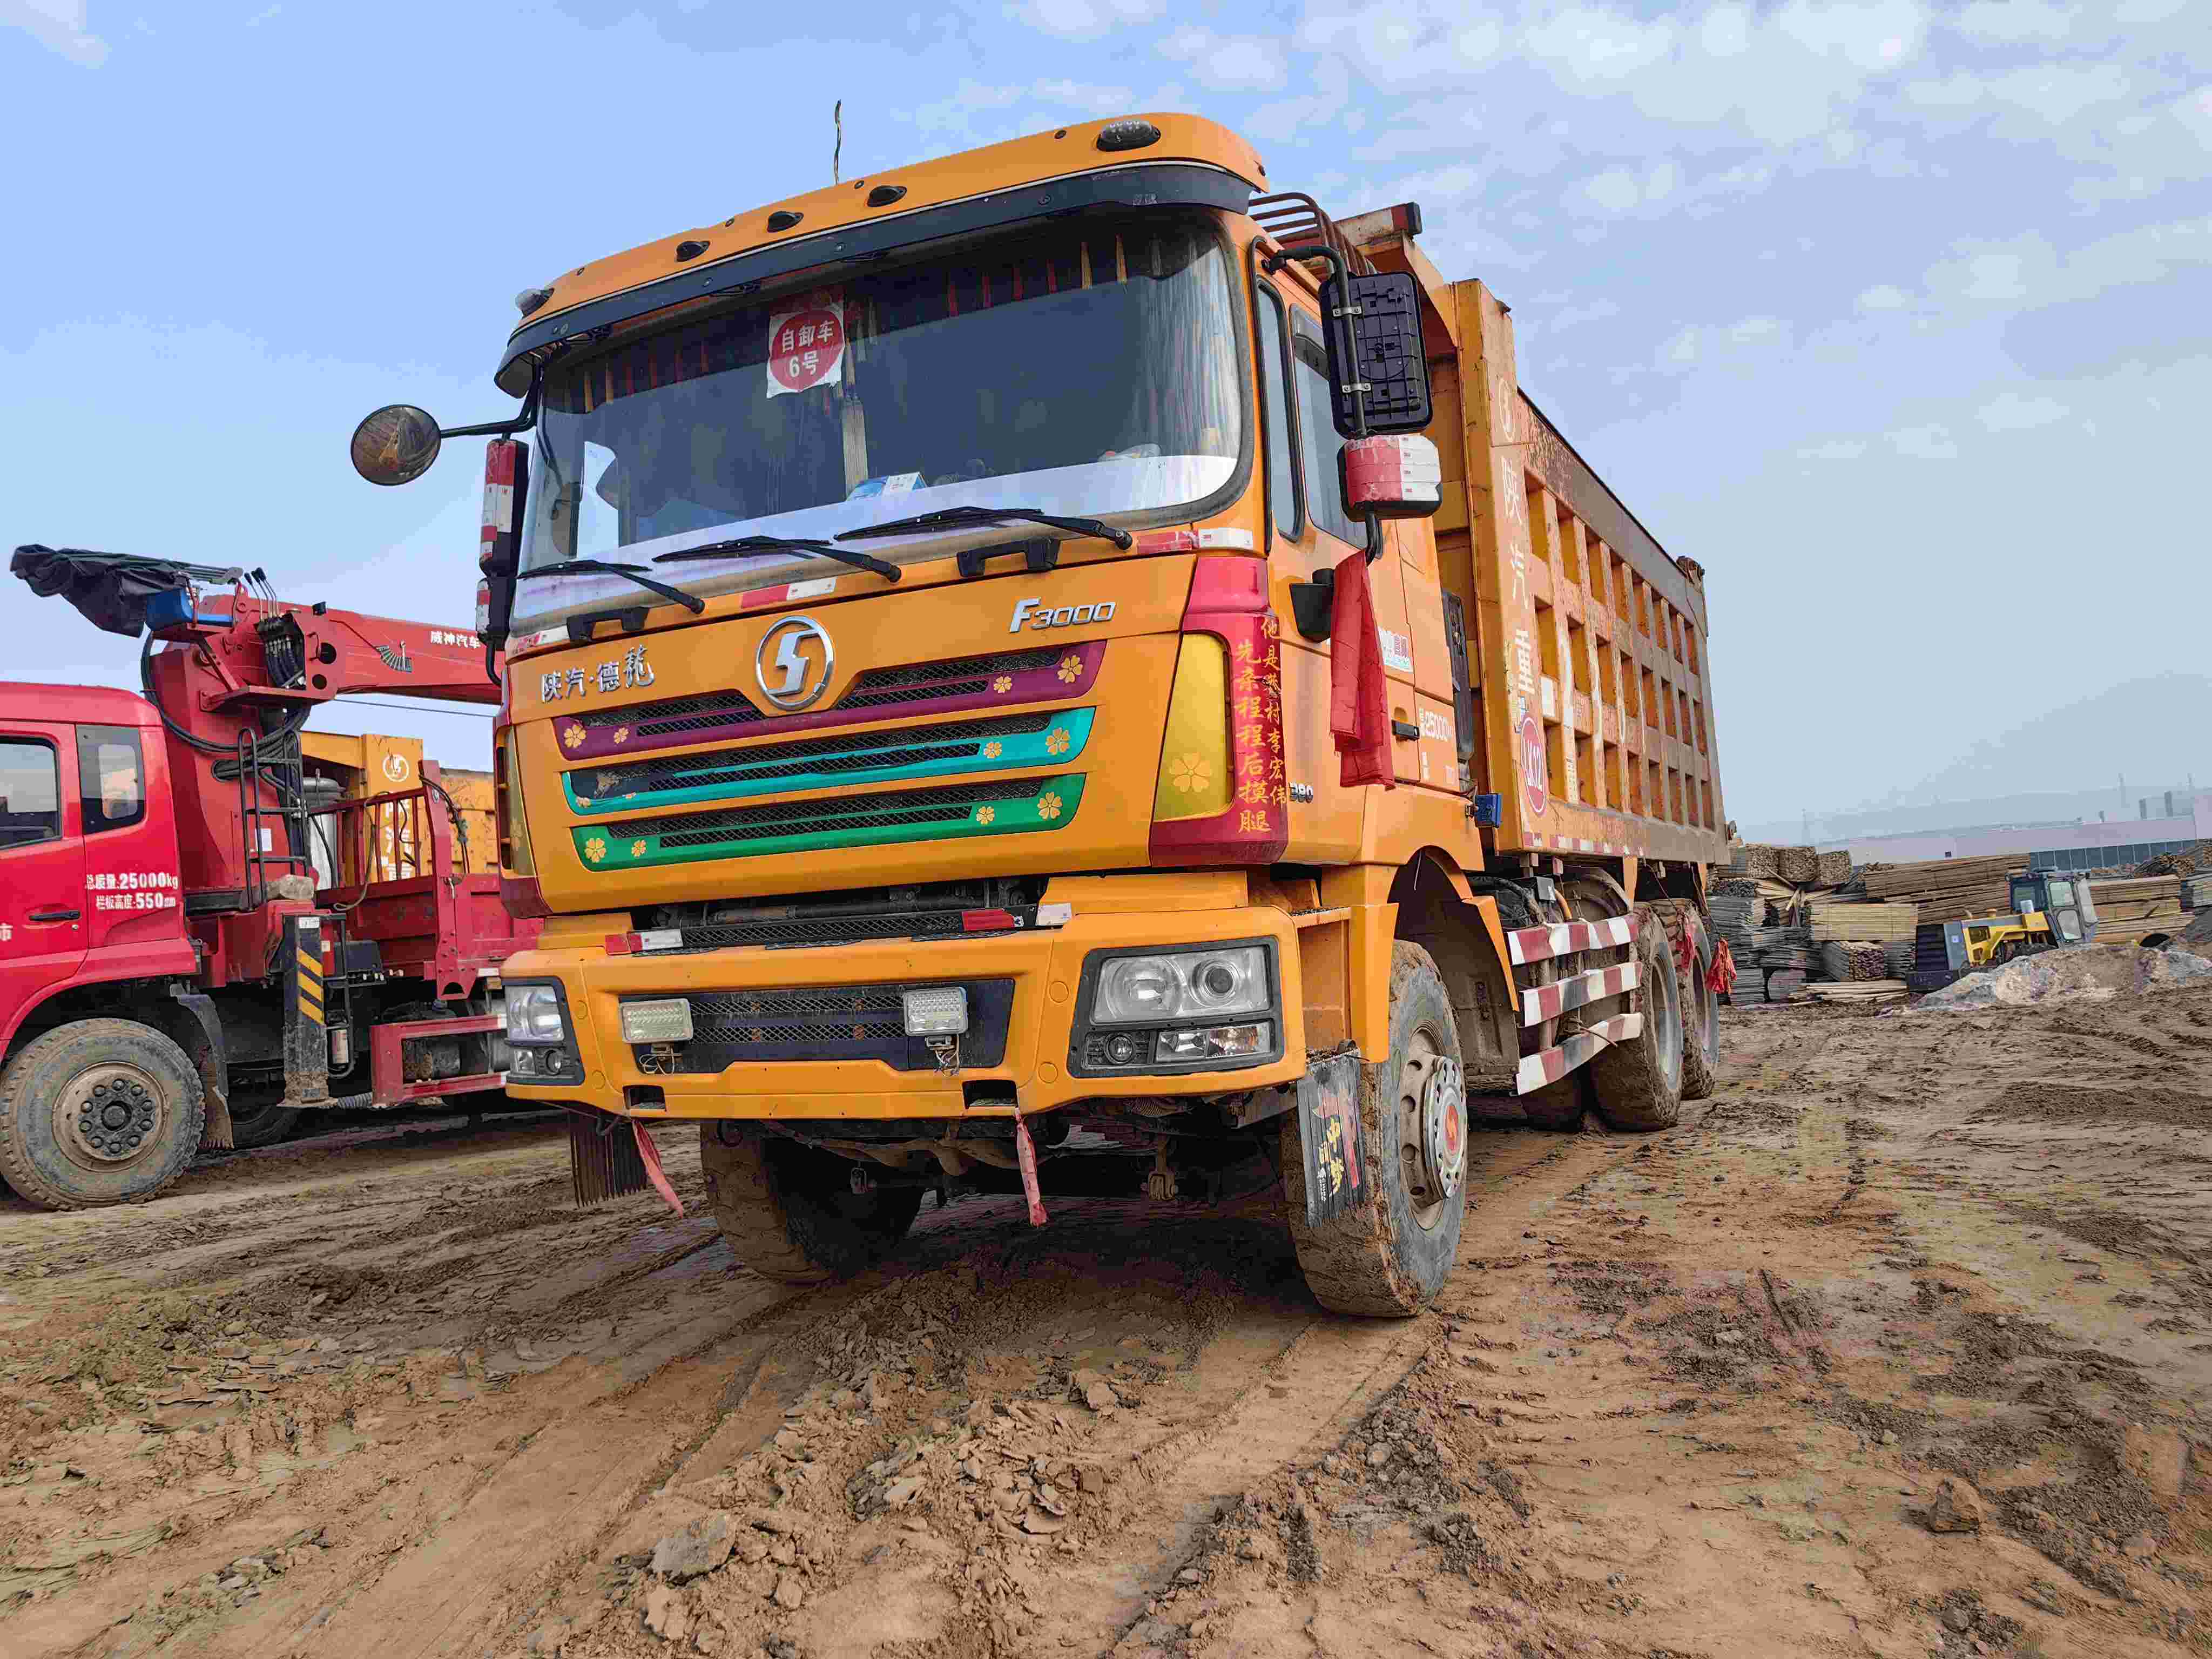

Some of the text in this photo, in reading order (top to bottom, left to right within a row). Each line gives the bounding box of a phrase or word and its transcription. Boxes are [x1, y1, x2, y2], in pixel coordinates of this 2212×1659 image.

[782, 321, 834, 353] 自卸车
[789, 350, 819, 377] 6号
[1009, 597, 1116, 633] F3000
